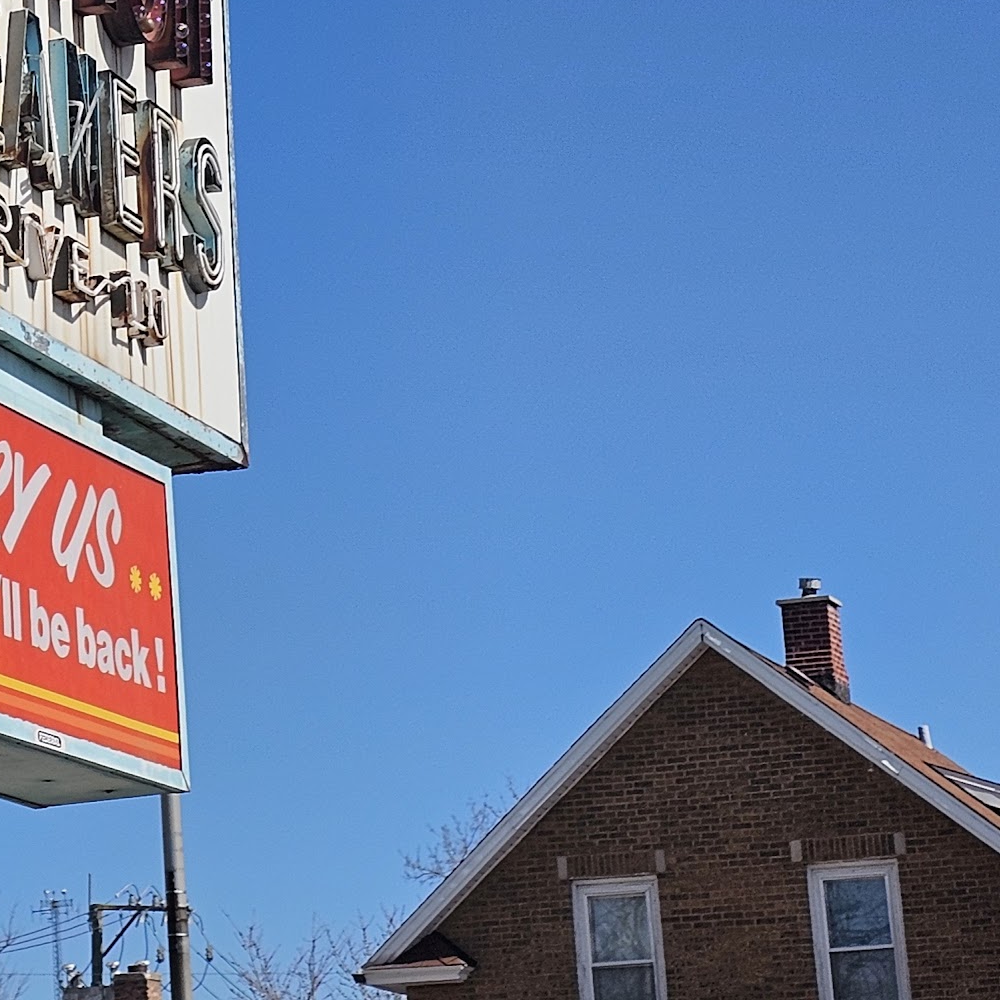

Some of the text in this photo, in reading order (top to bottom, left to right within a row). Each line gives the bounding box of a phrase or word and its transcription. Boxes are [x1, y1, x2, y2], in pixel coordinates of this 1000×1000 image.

[51, 479, 122, 589] US
[30, 588, 70, 659] be
[76, 606, 165, 693] back!
